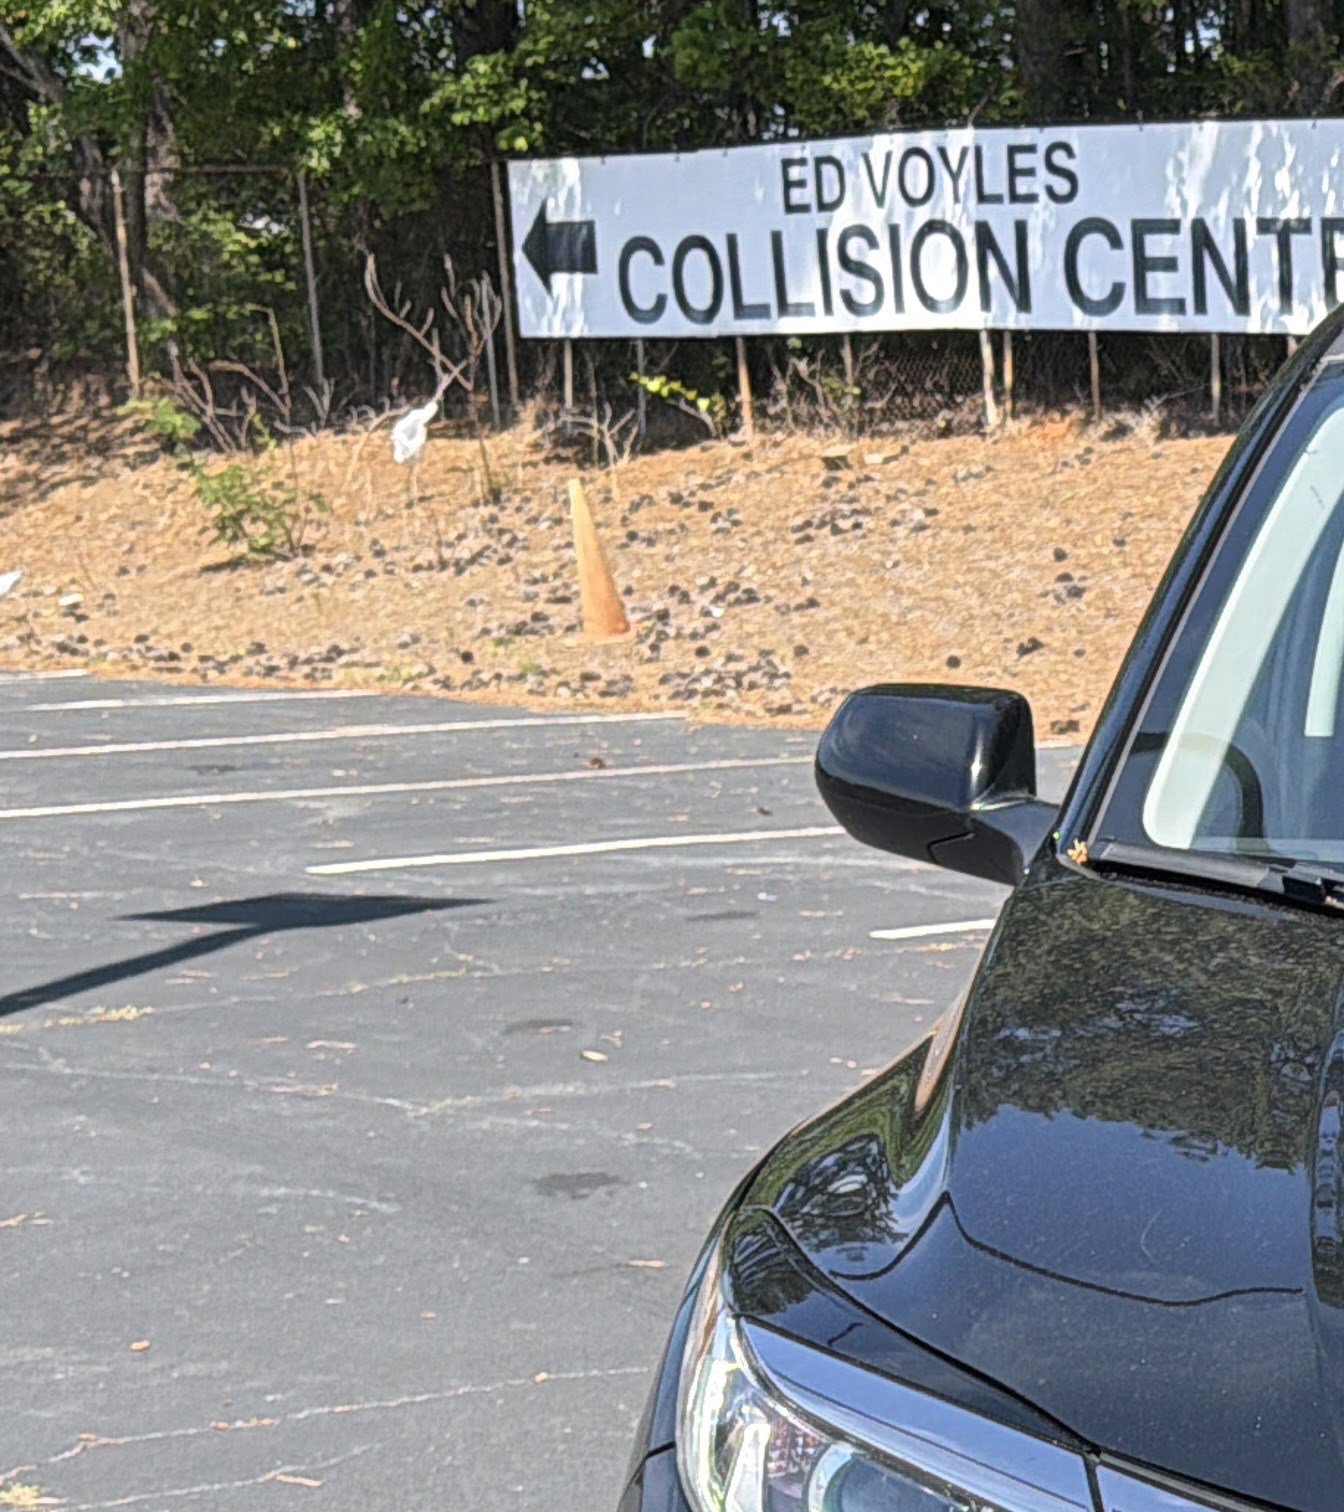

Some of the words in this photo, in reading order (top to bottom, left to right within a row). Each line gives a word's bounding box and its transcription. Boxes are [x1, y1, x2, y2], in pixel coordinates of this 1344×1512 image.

[781, 156, 847, 215] ED
[862, 141, 1079, 208] VOYLES
[618, 218, 1029, 325] COLLISION
